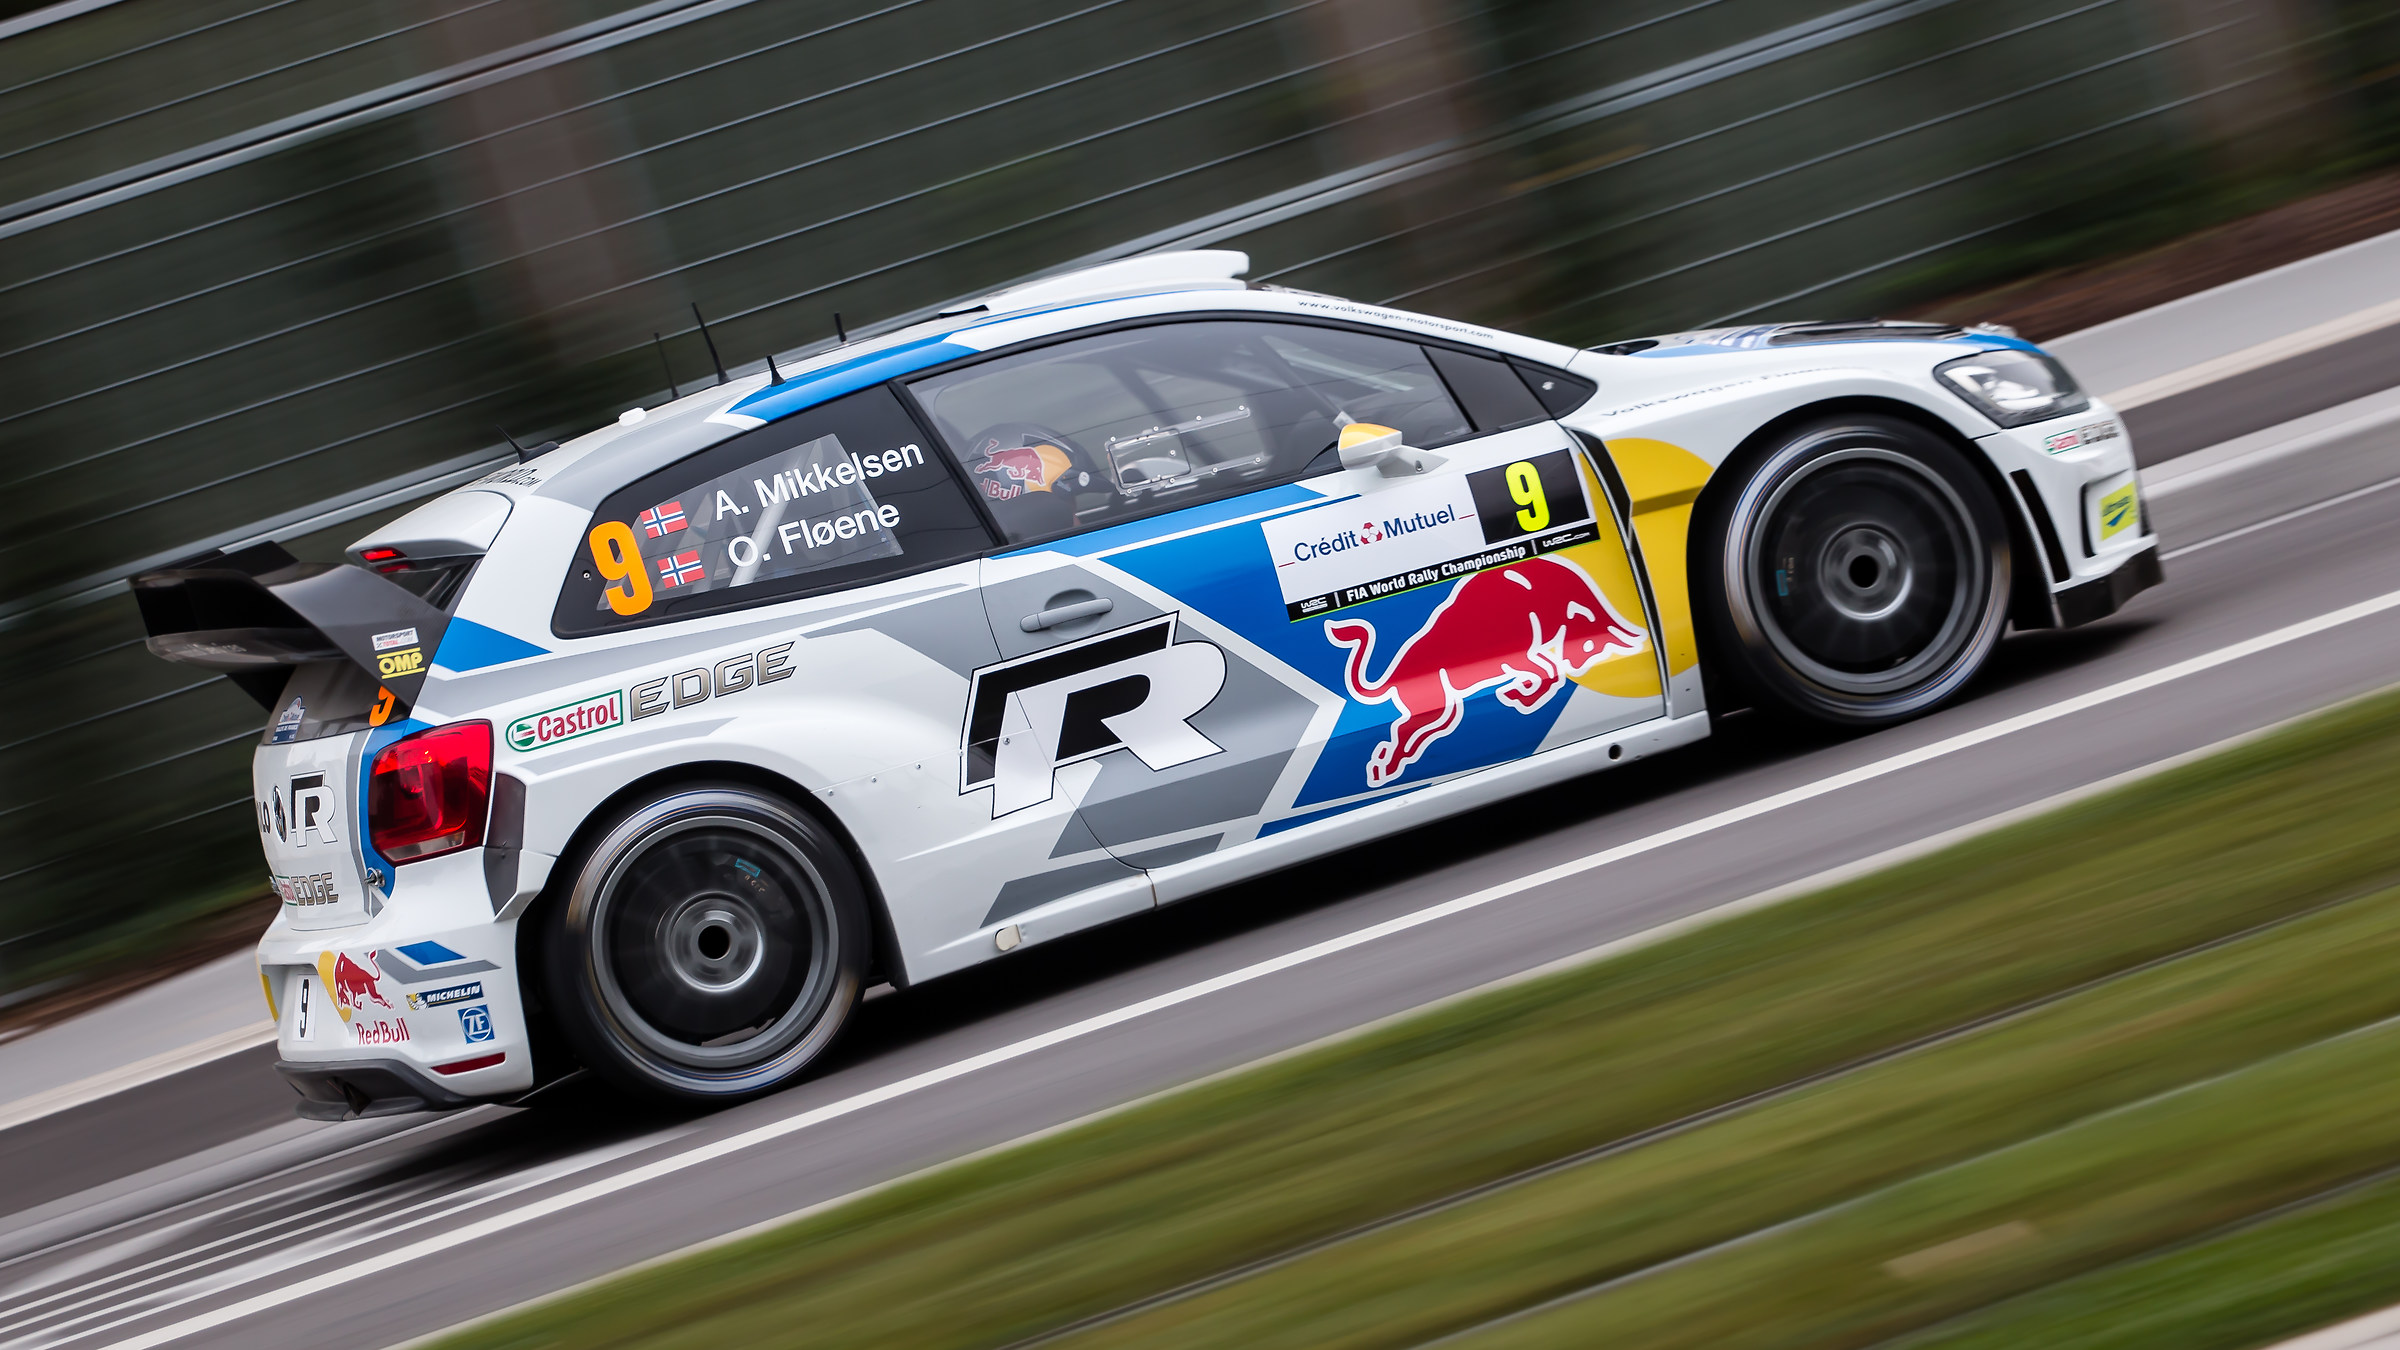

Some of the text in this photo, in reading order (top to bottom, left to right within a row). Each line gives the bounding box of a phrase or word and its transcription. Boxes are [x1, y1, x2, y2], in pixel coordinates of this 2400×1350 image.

[1298, 301, 1494, 339] www.volkswagen-motorsport.com
[716, 443, 926, 521] A. Mikkelsen
[987, 480, 1022, 501] Bull
[1504, 461, 1550, 532] 9
[727, 504, 901, 568] O. Fløene
[1293, 504, 1456, 563] Crédit Mutuel
[588, 521, 654, 616] 9
[1346, 586, 1370, 603] FIA
[1368, 574, 1406, 596] World
[1408, 568, 1440, 585] Rally
[1440, 544, 1527, 577] Championship
[378, 652, 423, 674] OMP
[538, 641, 797, 741] Castrol EDGE
[958, 610, 1228, 820] R
[290, 770, 338, 848] R
[291, 871, 339, 907] EDGE
[300, 979, 309, 1038] 9
[427, 985, 481, 1003] MICHELIN
[464, 1011, 489, 1036] ZF
[356, 1017, 410, 1045] Red Bull
